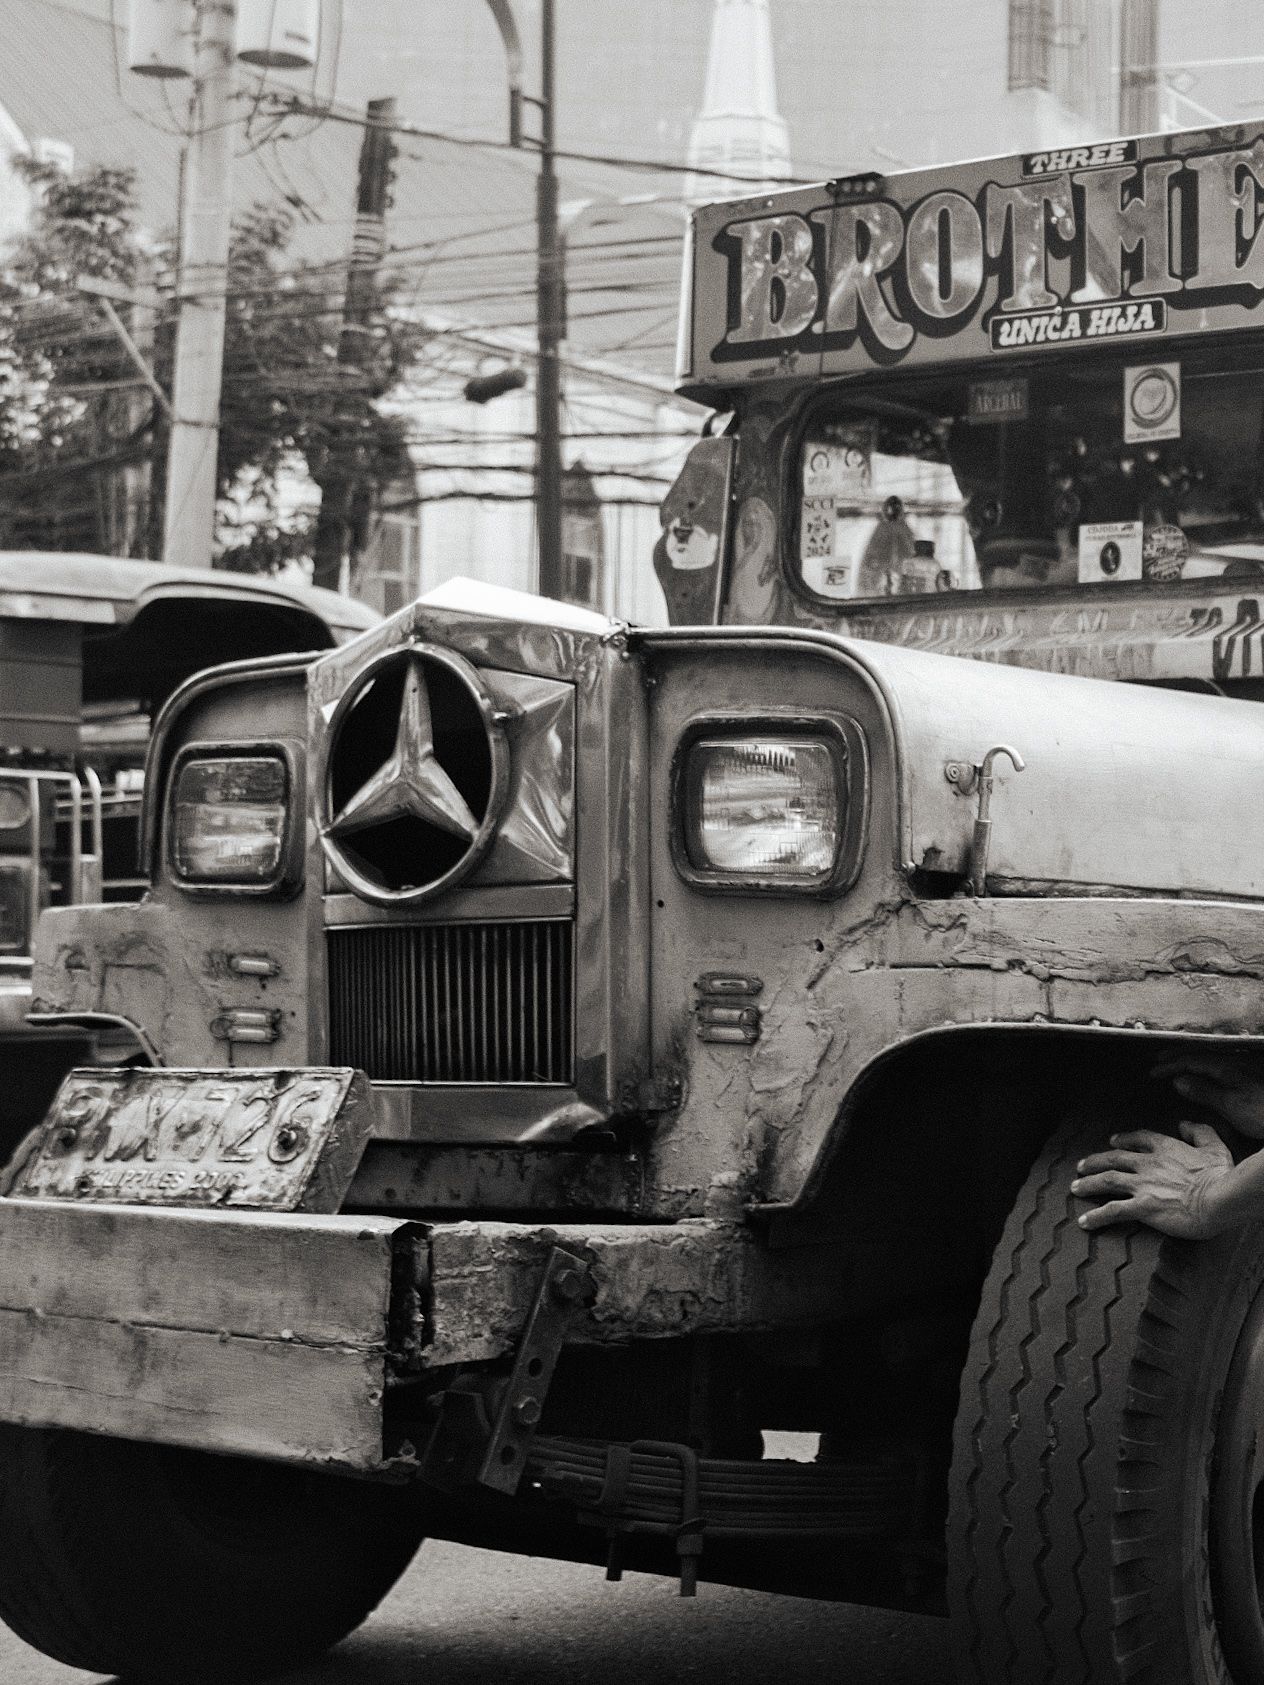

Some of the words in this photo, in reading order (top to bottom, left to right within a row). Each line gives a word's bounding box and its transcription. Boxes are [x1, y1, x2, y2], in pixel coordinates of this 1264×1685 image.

[1029, 141, 1129, 174] THREE
[998, 311, 1082, 346] UNICA
[1086, 303, 1156, 336] HIJA
